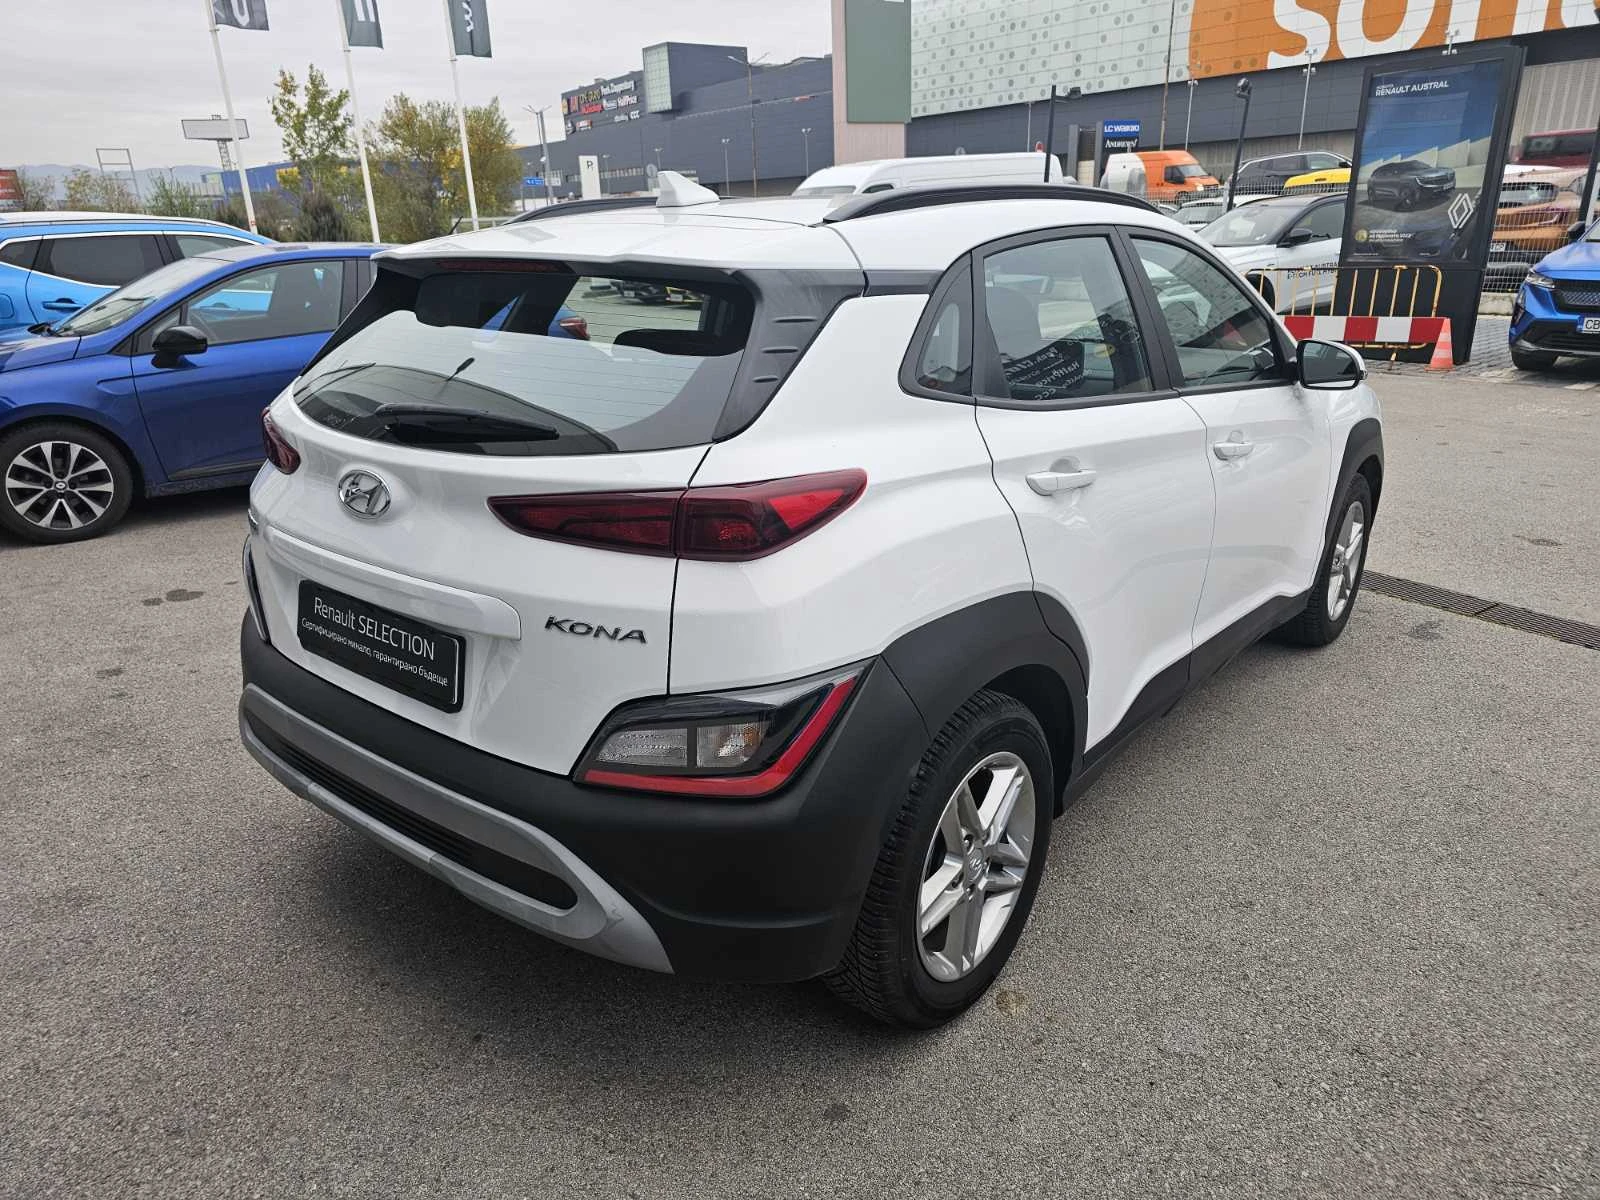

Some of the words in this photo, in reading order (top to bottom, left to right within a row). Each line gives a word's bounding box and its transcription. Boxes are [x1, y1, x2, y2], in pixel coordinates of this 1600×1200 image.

[1375, 86, 1411, 97] RENAULT
[1411, 80, 1449, 92] AUSTRAL
[301, 617, 348, 646] Сертифицирано
[348, 638, 372, 657] минало,
[373, 650, 418, 675] гарантирано
[418, 665, 449, 687] бъдеще
[314, 597, 356, 630] Renault
[358, 615, 435, 661] SELECTION
[544, 615, 646, 644] KONA
